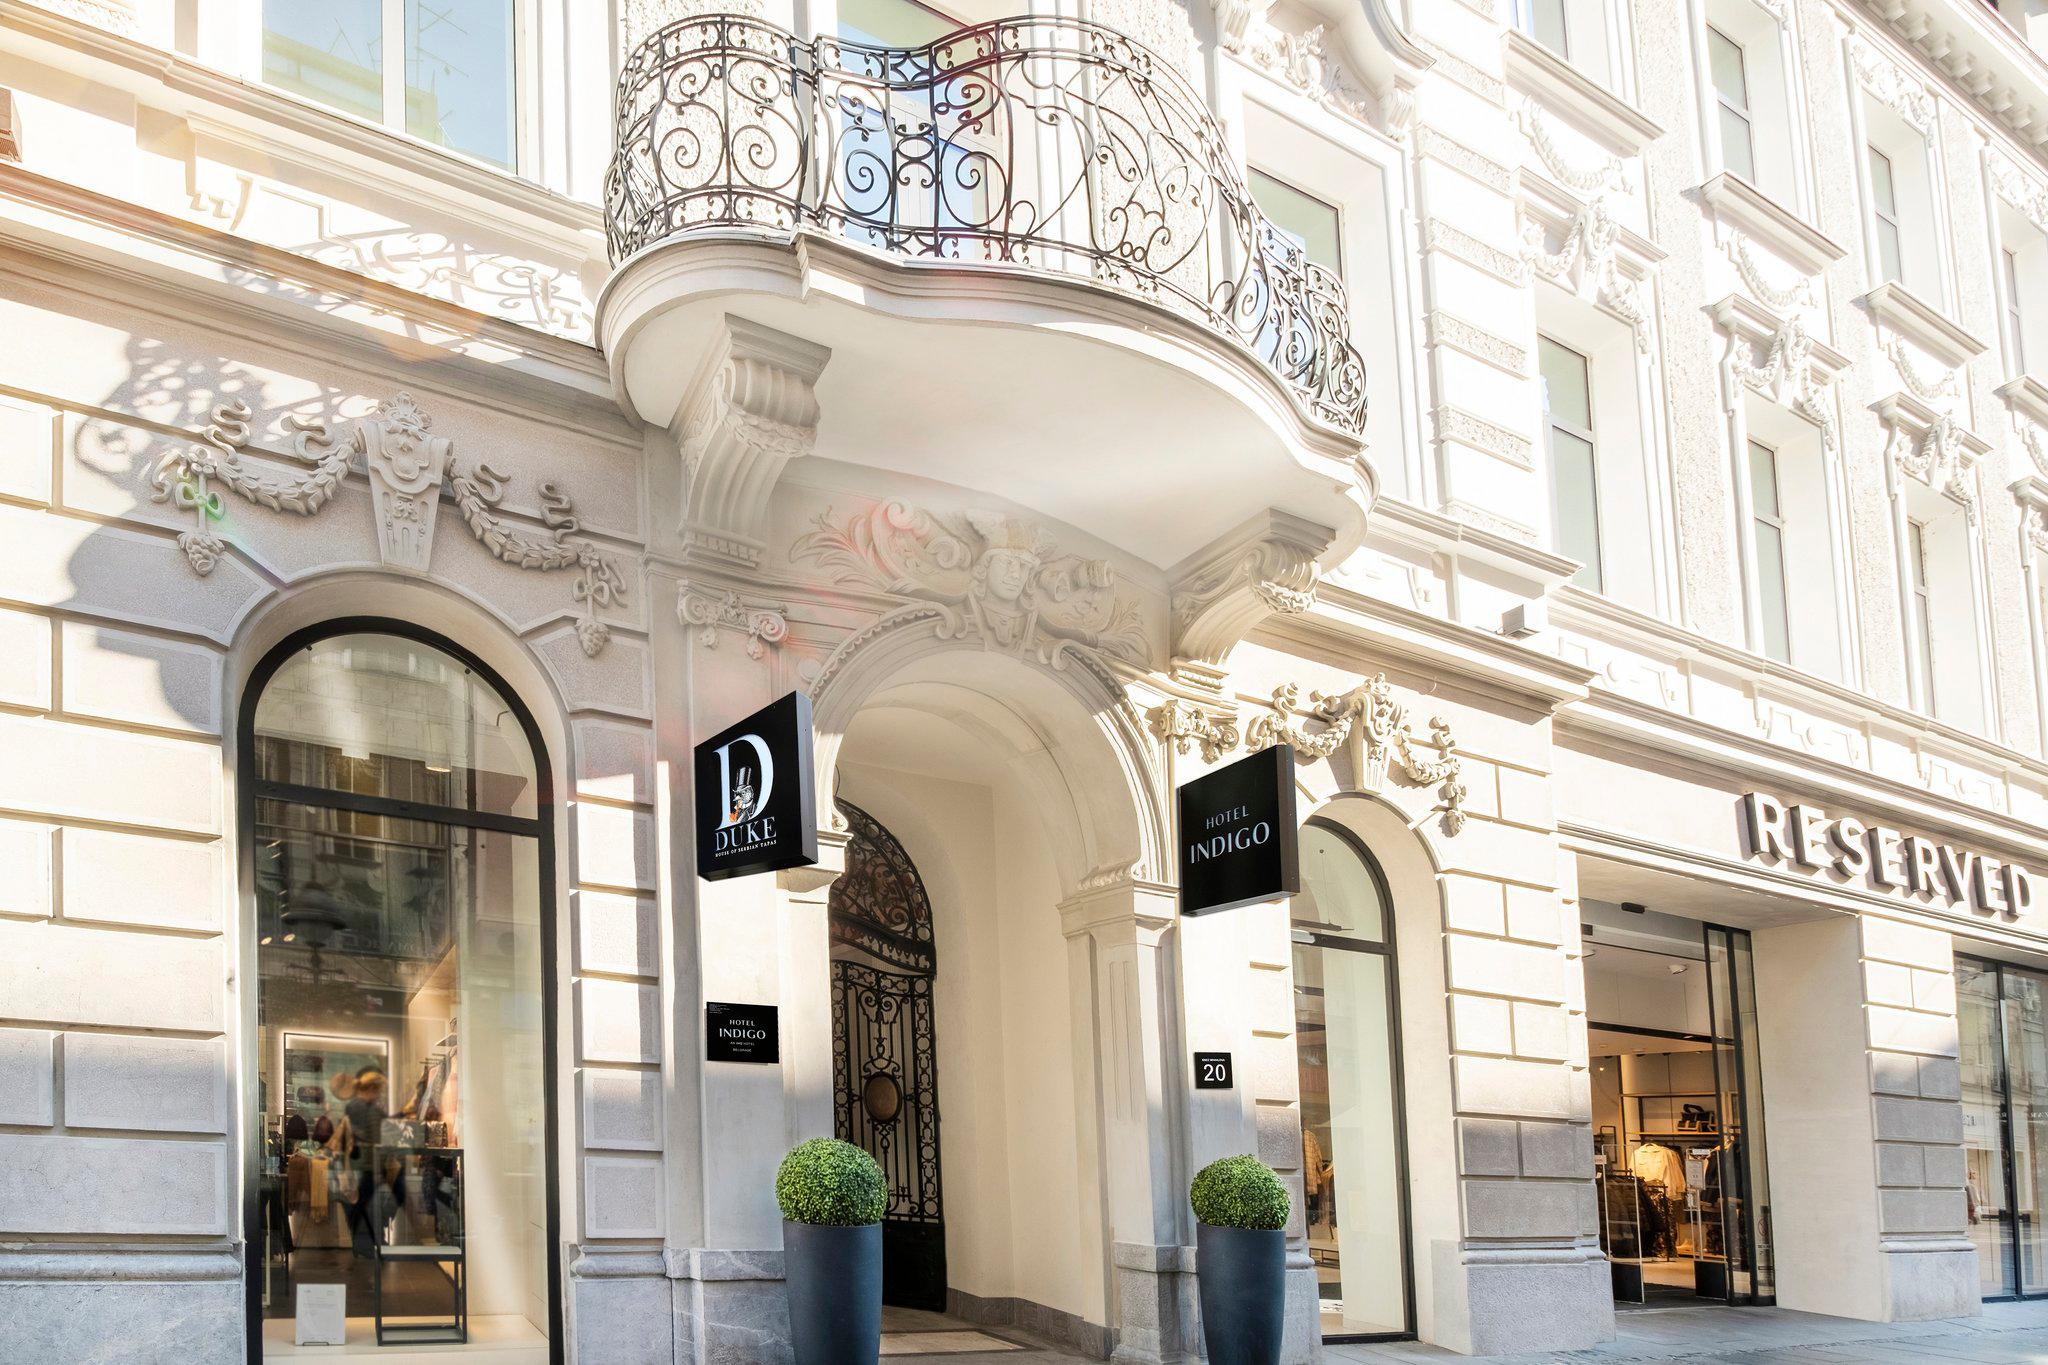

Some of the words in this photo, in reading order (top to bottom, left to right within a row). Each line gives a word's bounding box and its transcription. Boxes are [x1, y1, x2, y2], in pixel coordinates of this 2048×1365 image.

[1206, 805, 1249, 830] HOTEL
[715, 816, 777, 851] DUKE
[1190, 821, 1270, 864] INDIGO
[1738, 791, 2034, 919] RESERVED
[719, 1028, 766, 1040] INDIGO
[1203, 1064, 1226, 1081] 20
